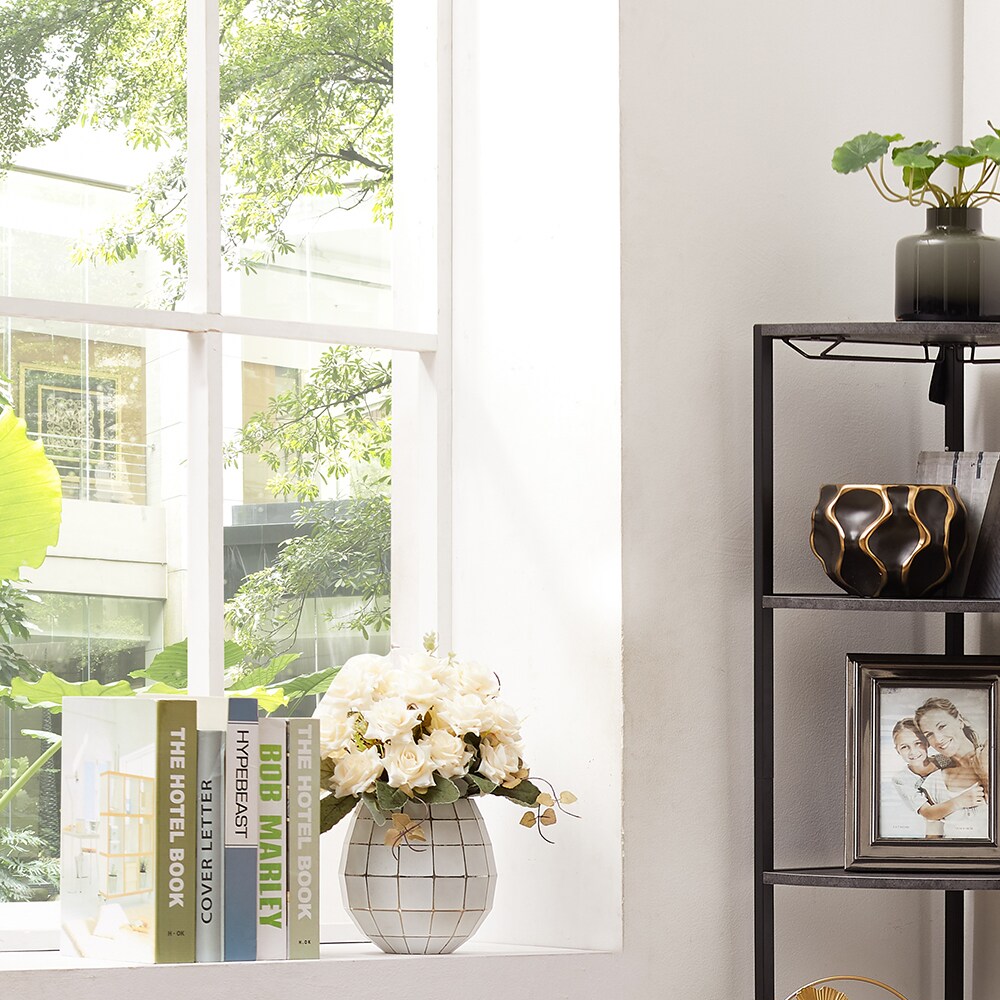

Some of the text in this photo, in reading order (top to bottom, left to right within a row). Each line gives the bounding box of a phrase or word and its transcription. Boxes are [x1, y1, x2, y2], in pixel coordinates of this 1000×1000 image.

[168, 727, 186, 908] THE HOTEL BOOK
[200, 779, 213, 924] COVER LETTER
[234, 729, 249, 839] HYPEBEAST
[258, 743, 283, 929] BOB MARLEY
[297, 724, 312, 921] THE HOTEL BOOK
